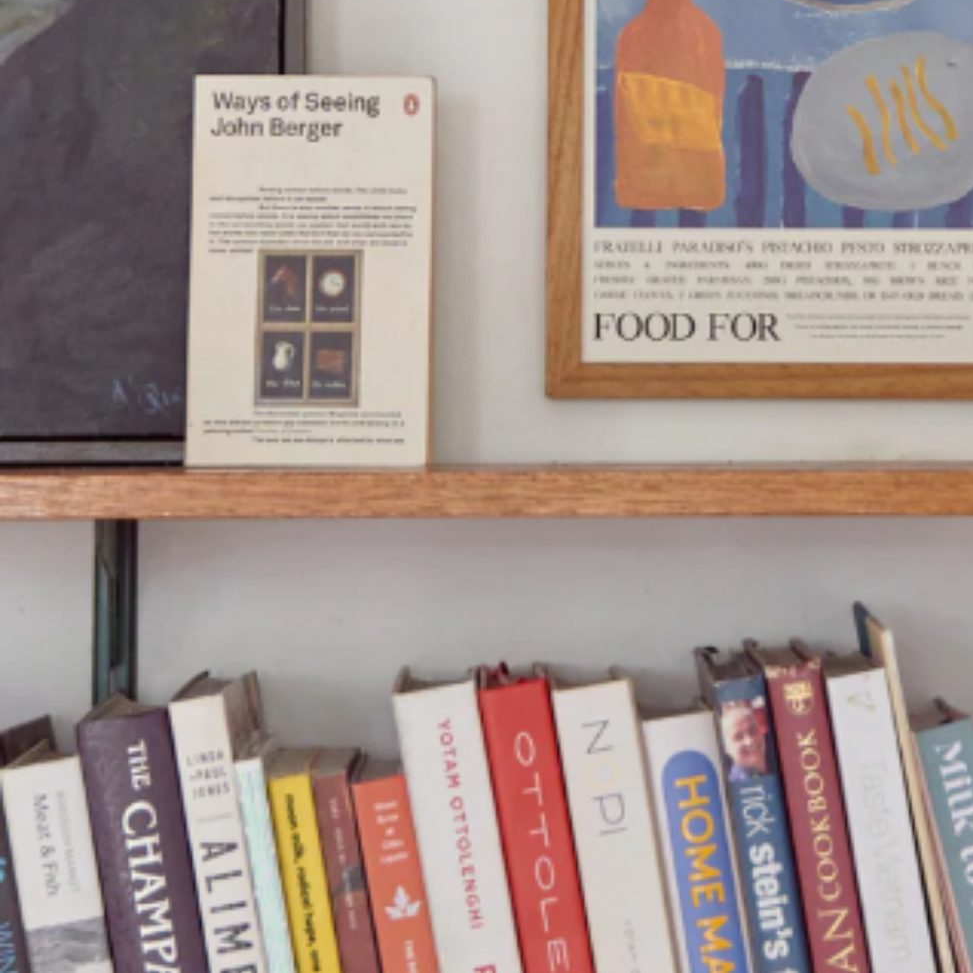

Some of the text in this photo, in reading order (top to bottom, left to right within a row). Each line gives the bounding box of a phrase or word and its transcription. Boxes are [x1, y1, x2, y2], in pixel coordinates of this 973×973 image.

[210, 116, 343, 143] John Berger
[211, 90, 380, 118] Ways of Seeing
[593, 312, 697, 342] FOOD
[706, 312, 782, 342] FOR
[128, 739, 151, 792] THE
[437, 717, 485, 930] YOTAM OTTOLENGHI
[581, 719, 628, 837] NOPI
[797, 729, 842, 902] COOKBOOK
[33, 794, 60, 897] Meat & Fish
[514, 731, 570, 972] OTTOLE
[674, 774, 727, 907] HOME
[738, 785, 793, 960] rick stein's
